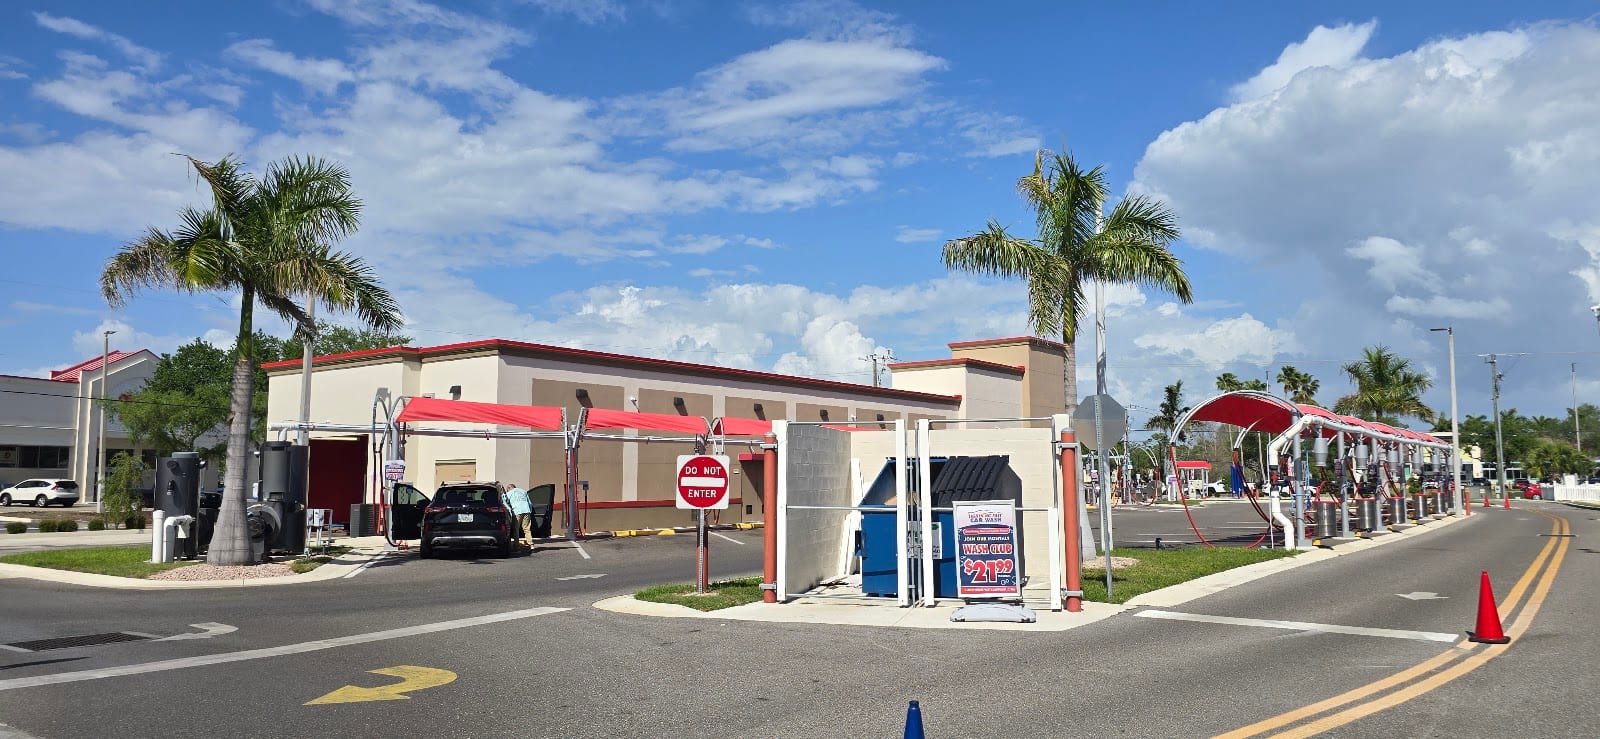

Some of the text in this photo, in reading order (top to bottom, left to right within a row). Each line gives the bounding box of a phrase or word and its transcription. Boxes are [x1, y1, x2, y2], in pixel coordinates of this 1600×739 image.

[685, 466, 721, 475] DO NOT
[688, 489, 717, 498] ENTER
[963, 543, 1012, 555] WASH CLUB
